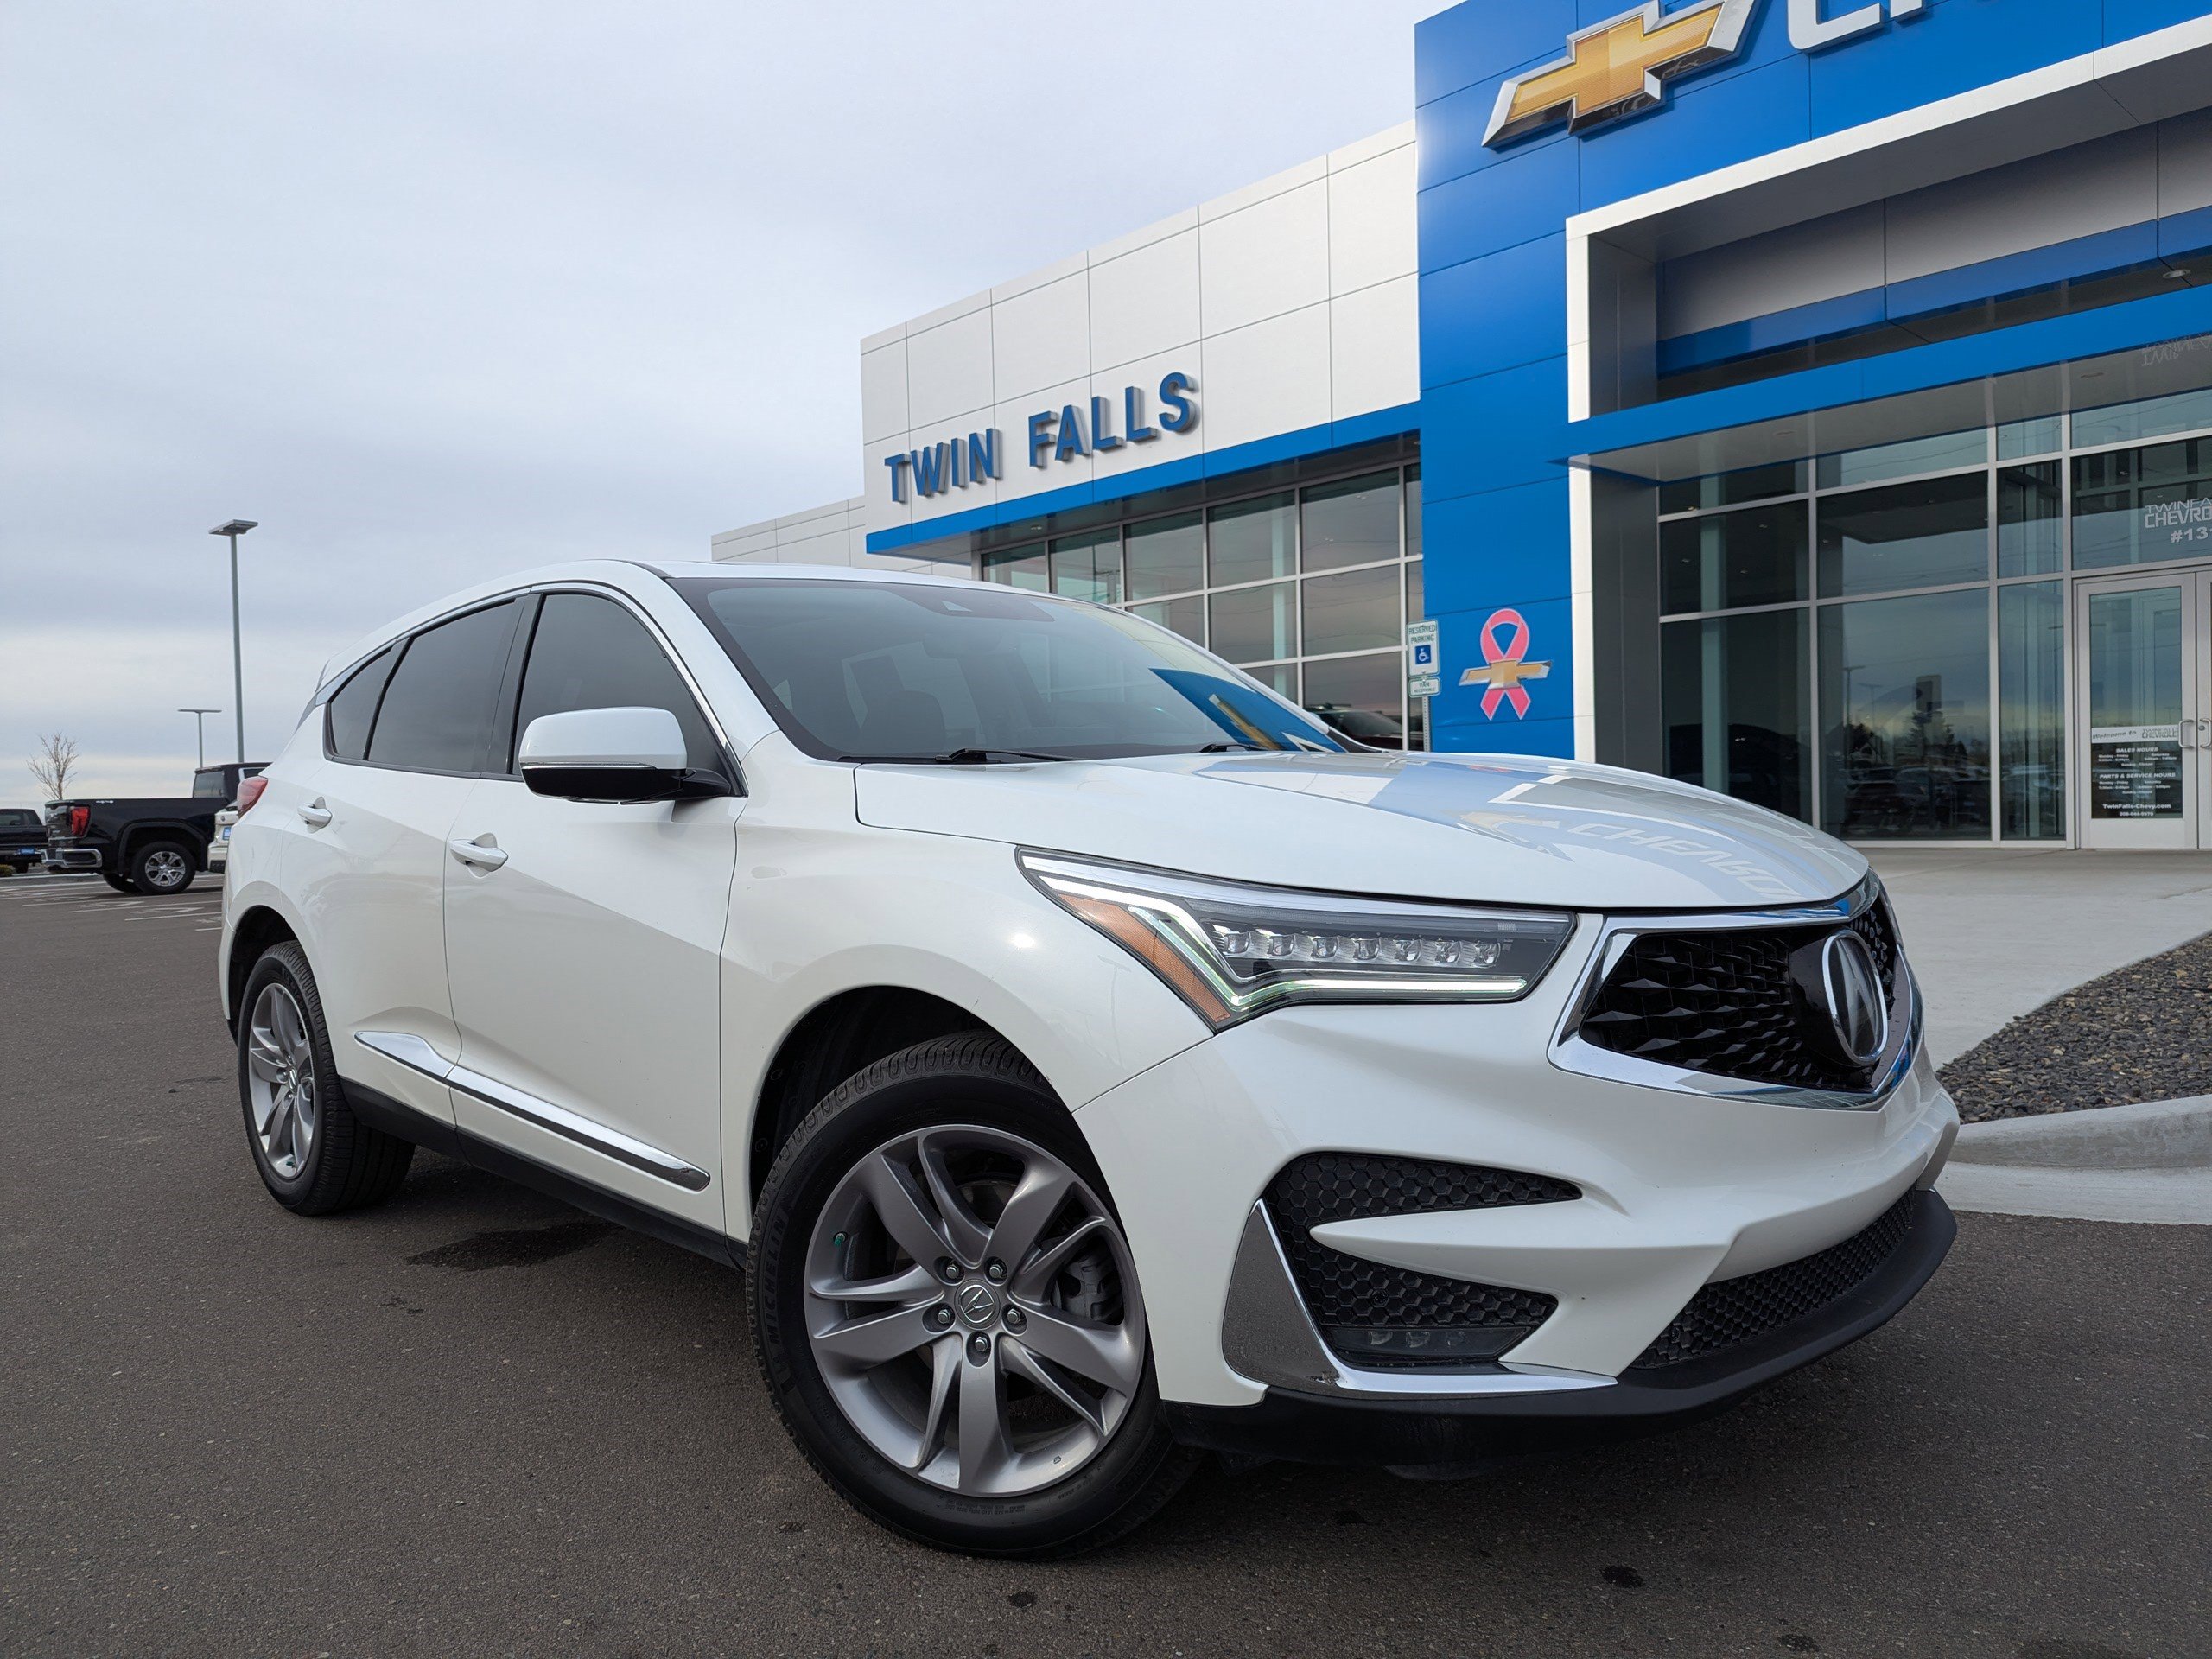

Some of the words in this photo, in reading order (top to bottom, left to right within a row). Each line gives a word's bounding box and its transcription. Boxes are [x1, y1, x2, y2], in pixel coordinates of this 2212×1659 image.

[885, 428, 1003, 503] TWIN
[1028, 372, 1200, 468] FALLS
[1408, 625, 1436, 634] RESERVED
